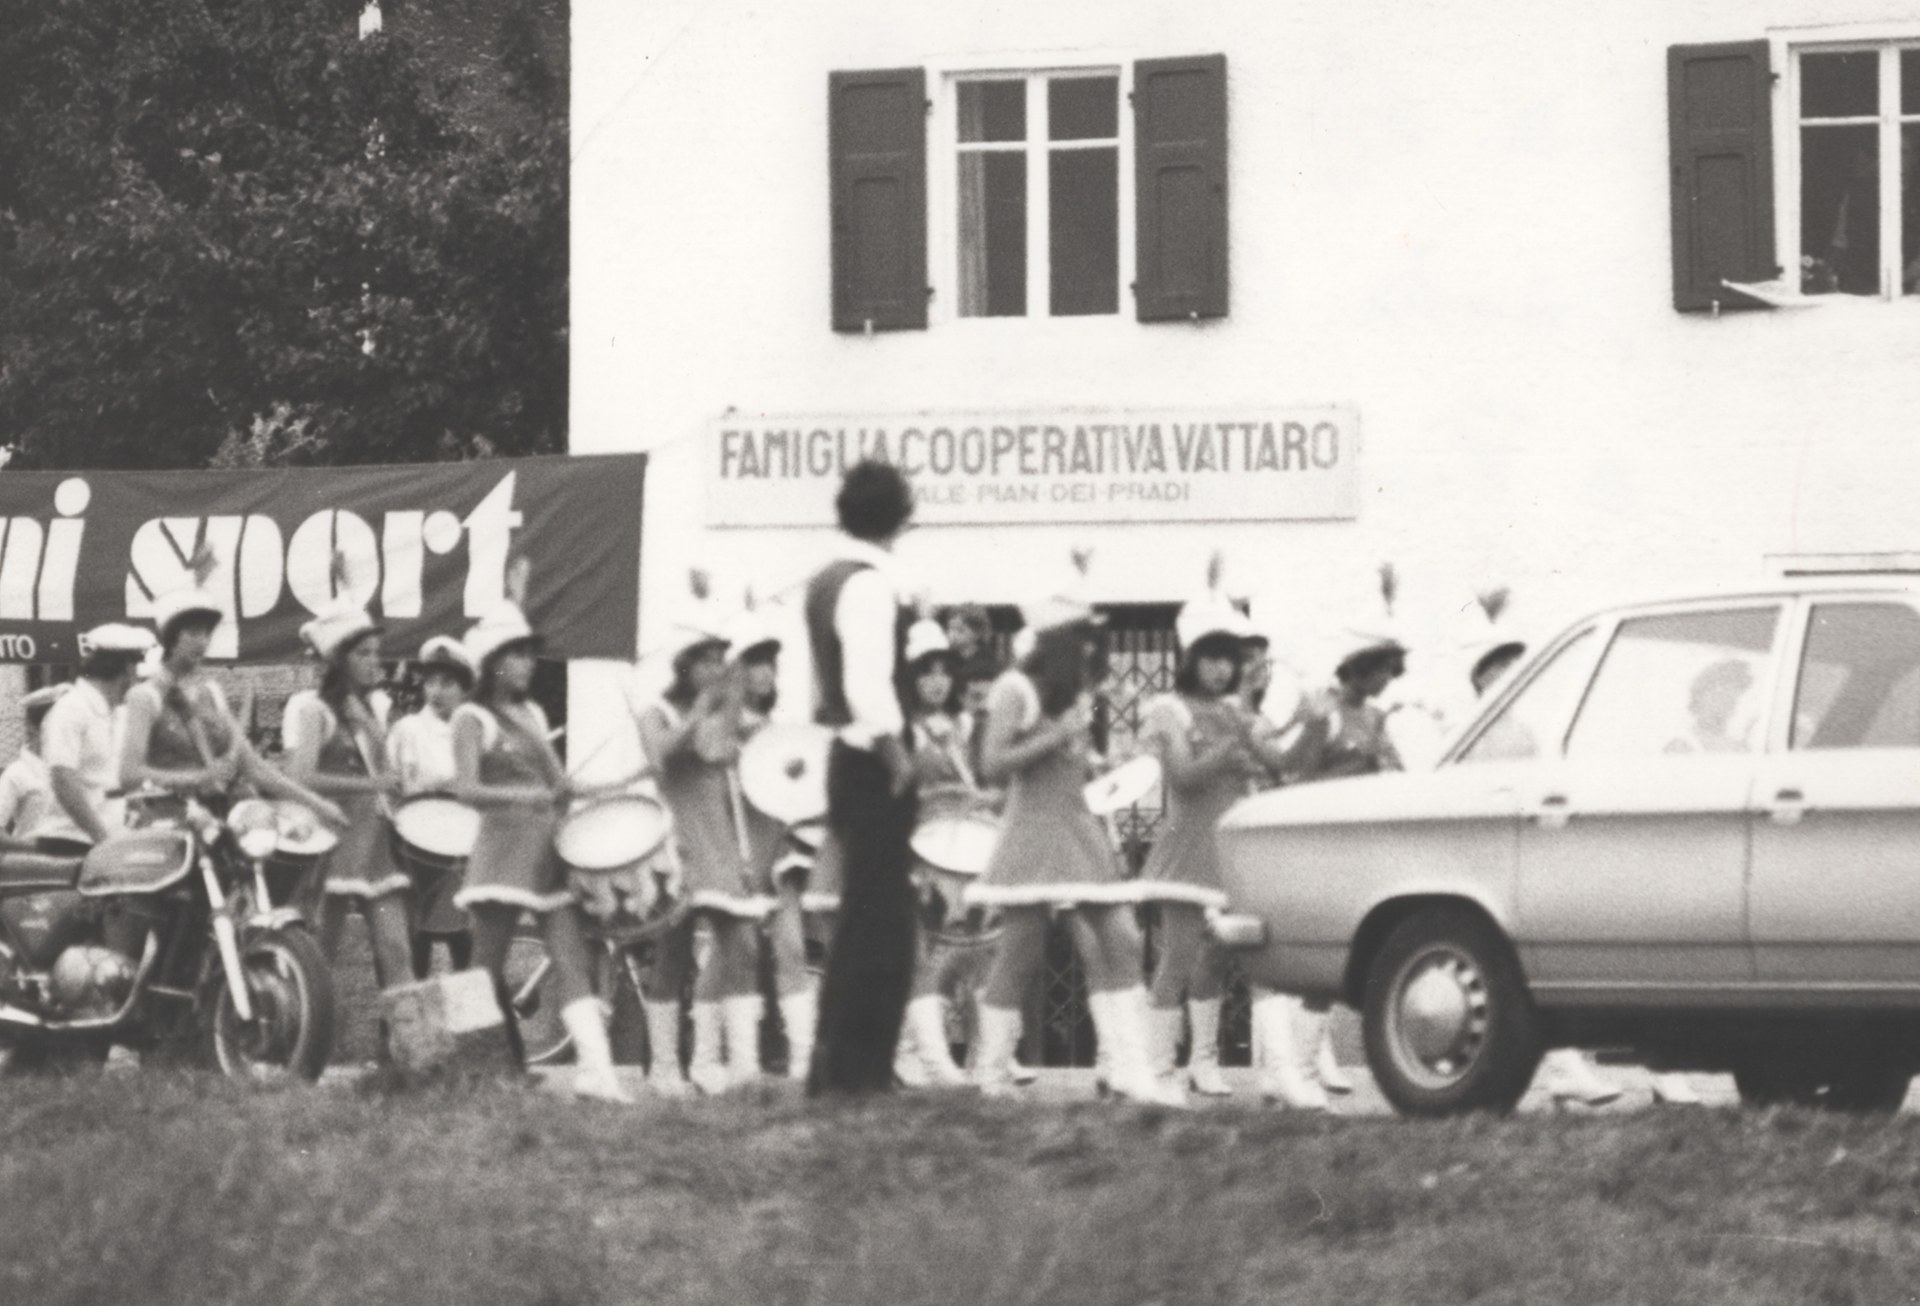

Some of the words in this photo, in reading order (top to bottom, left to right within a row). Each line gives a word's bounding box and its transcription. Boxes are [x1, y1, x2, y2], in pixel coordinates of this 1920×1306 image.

[900, 424, 1166, 476] COOPERATIVA
[1172, 421, 1339, 473] VATTARO
[914, 484, 966, 504] ALE
[1051, 482, 1096, 502] DEI
[1108, 481, 1190, 502] PRADI
[125, 470, 521, 658] sport
